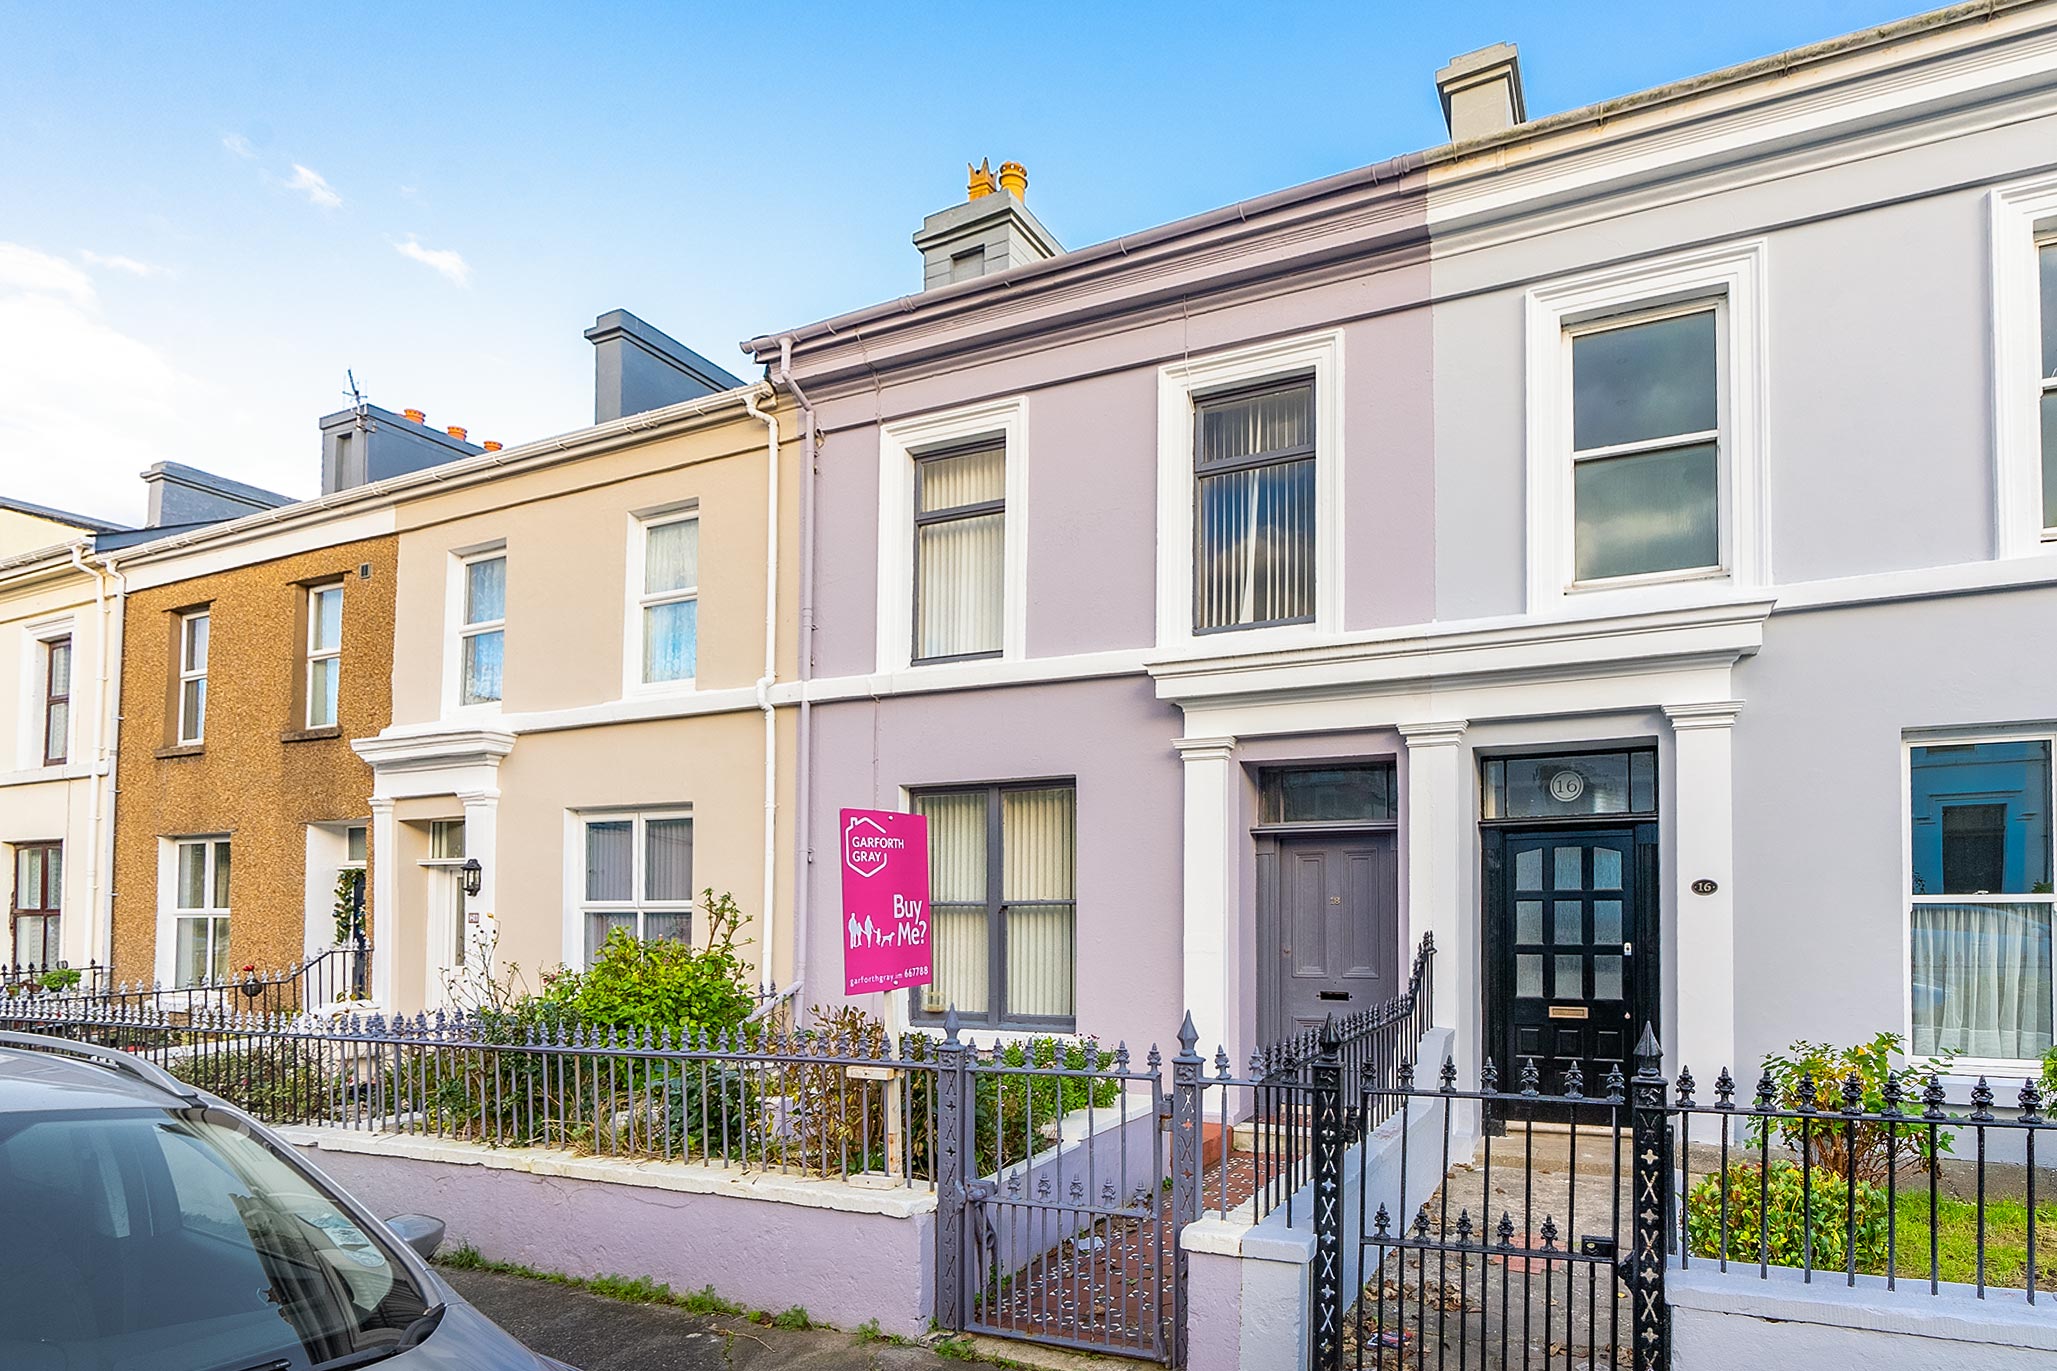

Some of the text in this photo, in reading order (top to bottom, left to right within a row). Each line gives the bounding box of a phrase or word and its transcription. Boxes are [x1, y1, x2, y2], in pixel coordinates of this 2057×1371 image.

[1556, 779, 1578, 793] 16
[852, 836, 905, 849] GARFORTH
[852, 850, 882, 862] GRAY
[1698, 882, 1712, 892] 16
[893, 894, 923, 925] Buy
[897, 920, 927, 947] Me?
[904, 965, 929, 978] 667788
